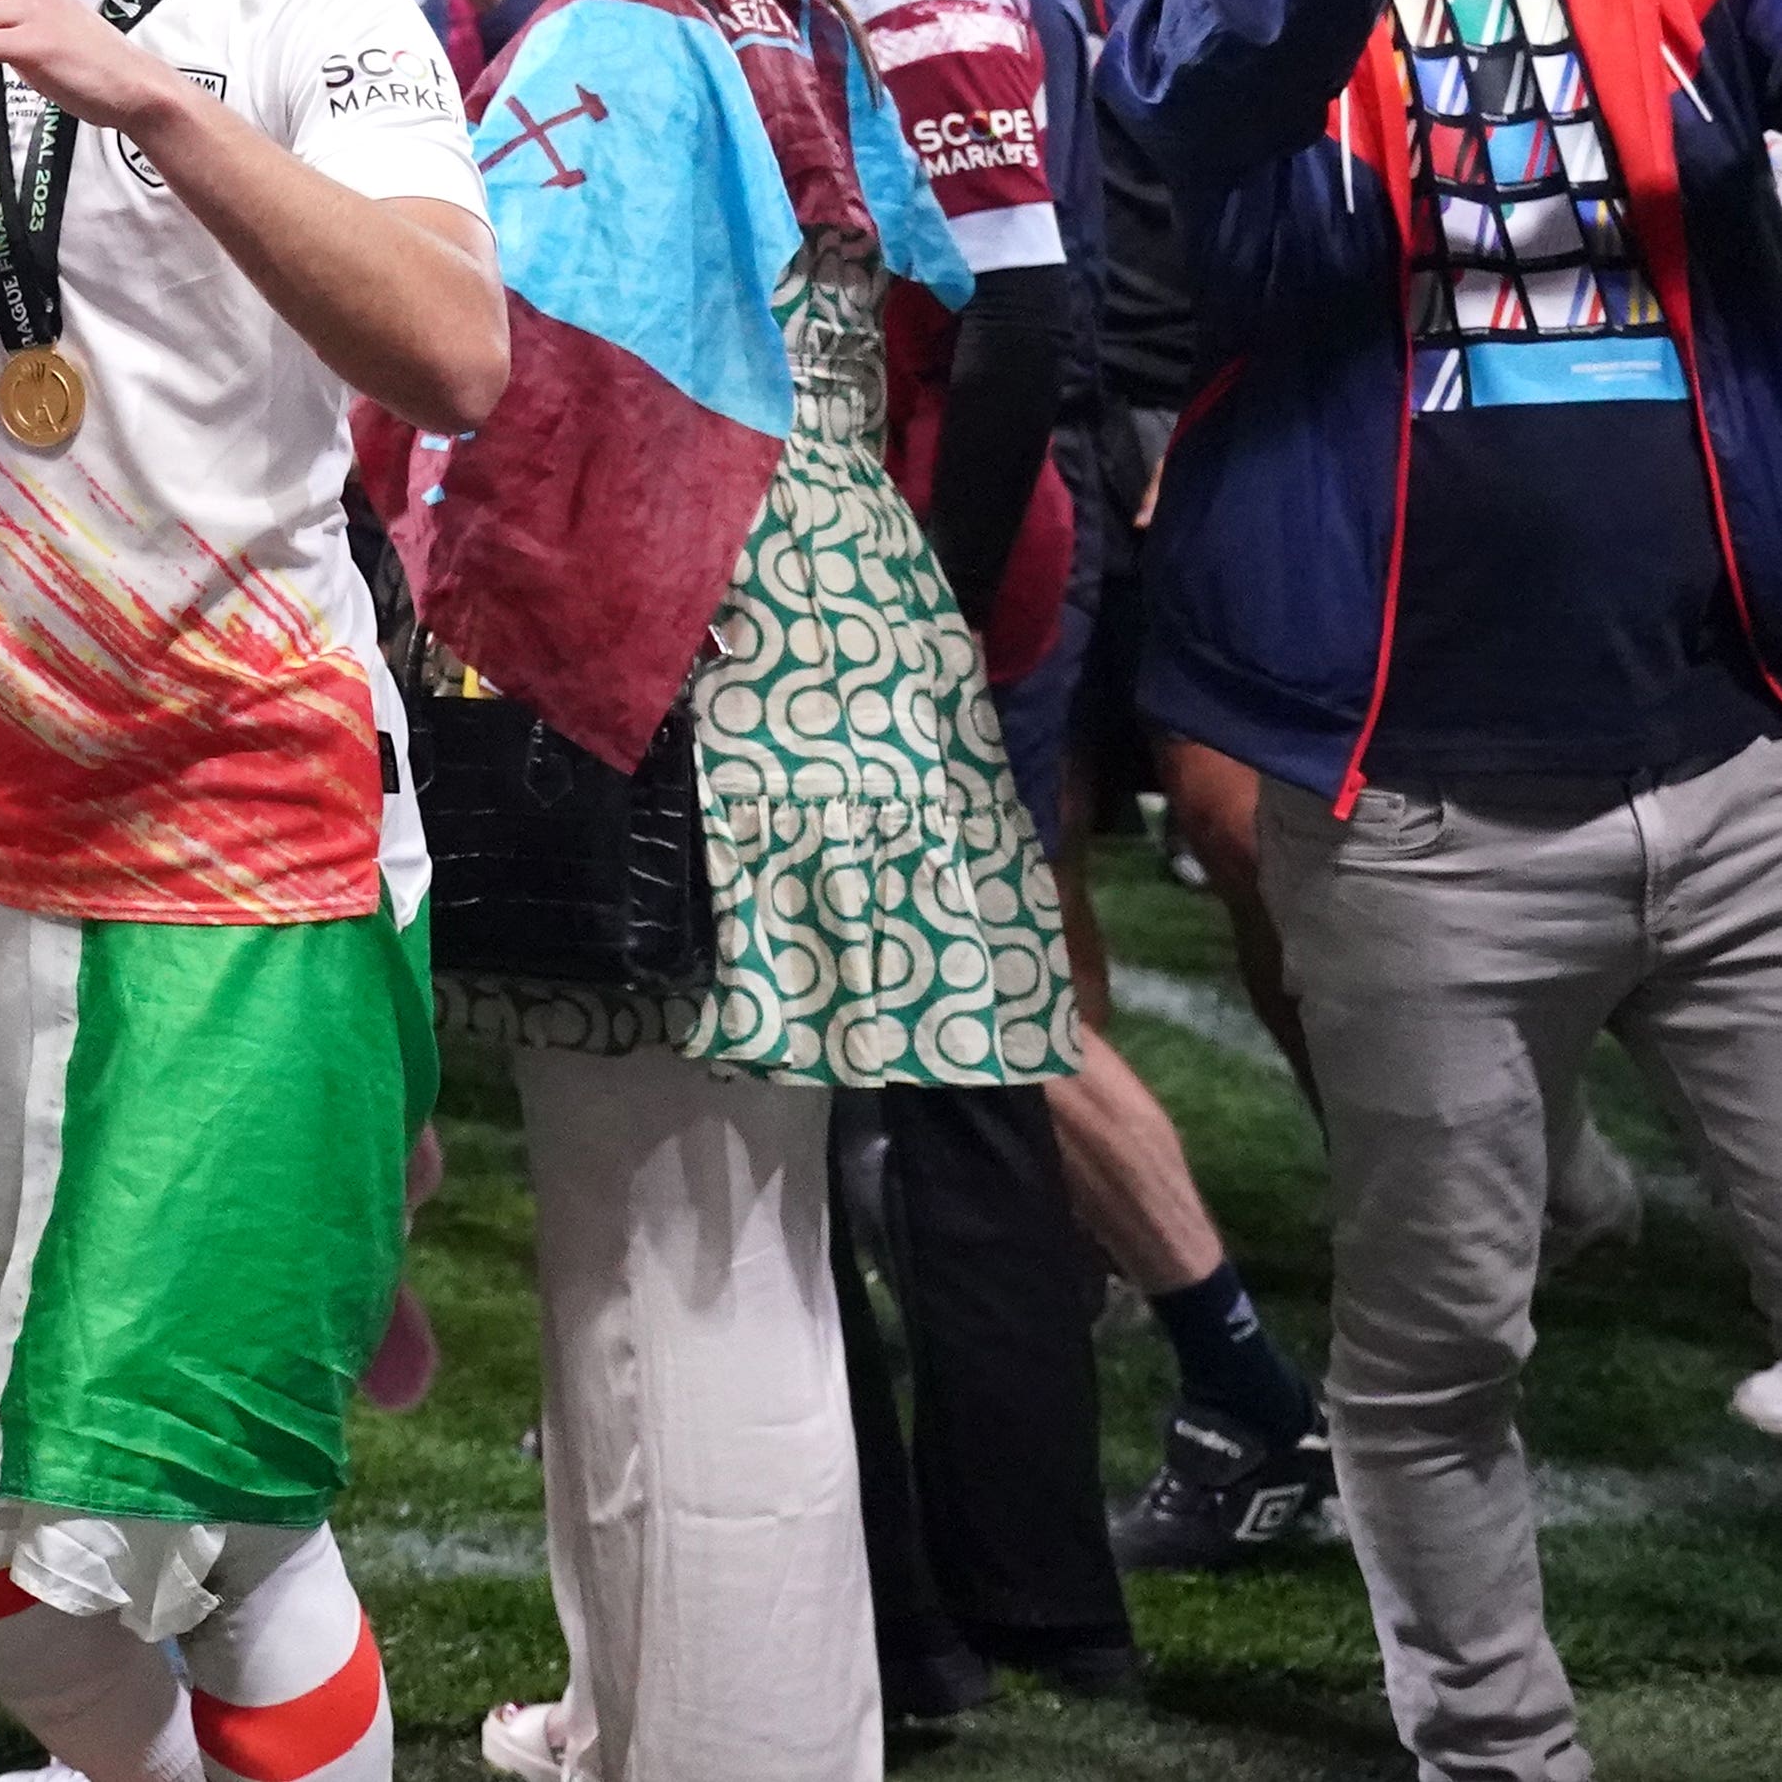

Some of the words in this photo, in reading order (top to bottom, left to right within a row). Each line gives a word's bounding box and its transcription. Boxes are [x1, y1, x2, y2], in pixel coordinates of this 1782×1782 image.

[329, 83, 459, 124] MARKE
[913, 107, 1034, 154] SCOPE
[38, 100, 61, 165] INAL
[923, 139, 1039, 179] MARKETS
[29, 168, 52, 233] 2023
[2, 275, 38, 348] RAGUE
